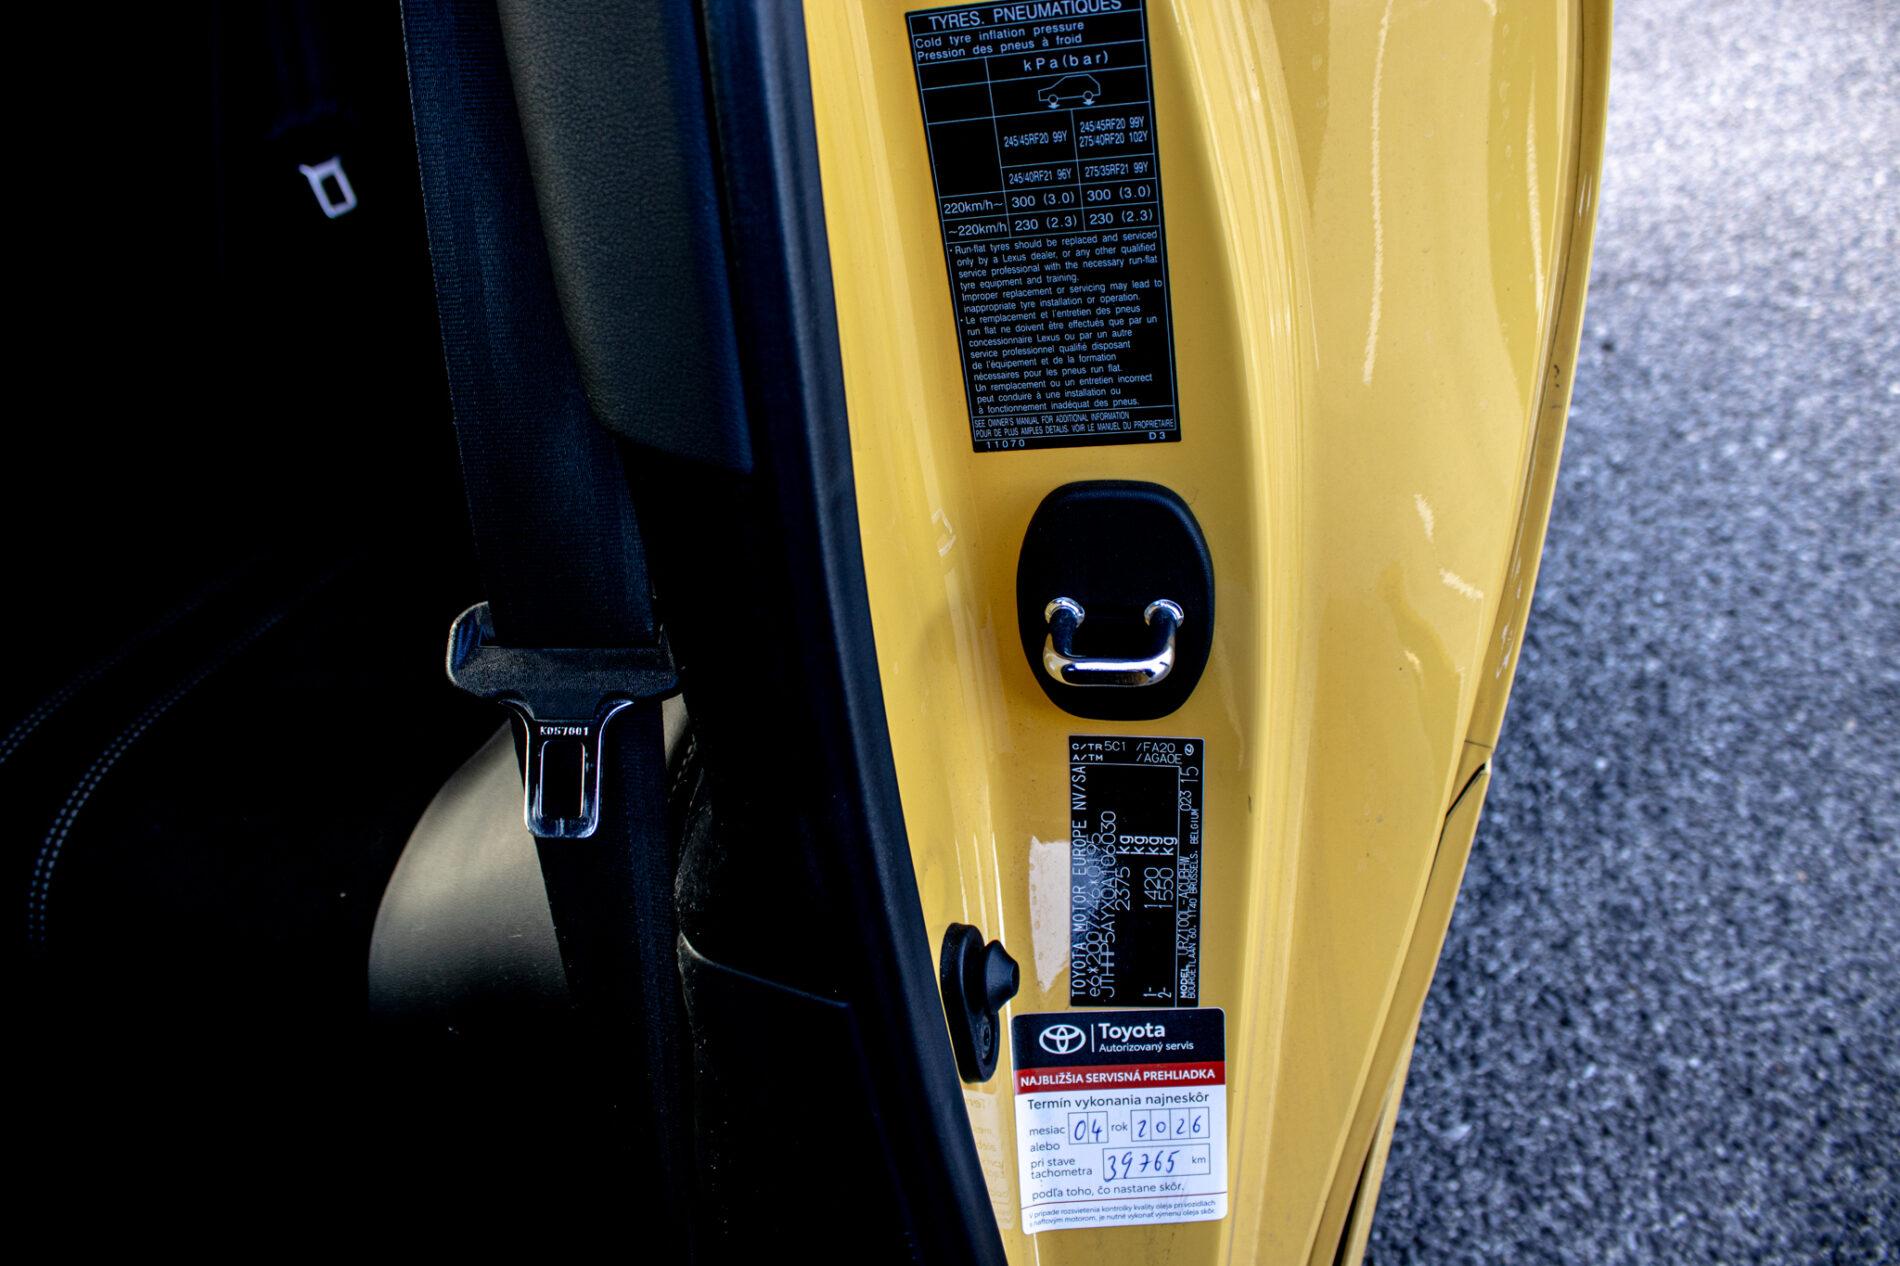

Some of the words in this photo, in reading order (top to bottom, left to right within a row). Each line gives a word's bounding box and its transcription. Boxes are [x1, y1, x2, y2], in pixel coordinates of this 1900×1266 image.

[928, 12, 984, 30] TYRES.
[994, 0, 1122, 22] PNEUMATIQUES
[915, 36, 941, 48] Cold
[948, 34, 971, 46] tyre
[978, 28, 1025, 40] inflation
[1032, 21, 1084, 36] pressure
[917, 44, 965, 60] Pression
[972, 44, 992, 54] des
[1000, 40, 1034, 53] pneus
[1042, 36, 1048, 46] à
[1055, 33, 1082, 44] froid
[1129, 115, 1144, 128] 99Y
[1052, 130, 1066, 142] 99Y
[1128, 130, 1147, 142] 102Y
[1056, 168, 1071, 179] 96Y
[1133, 161, 1148, 173] 99Y
[1011, 195, 1035, 207] 300
[1043, 191, 1074, 204] (3.0)
[1086, 188, 1111, 201] 300
[1119, 184, 1150, 198] (3.0)
[1014, 218, 1038, 230] 230
[1046, 214, 1076, 228] (2.3)
[1089, 212, 1113, 224] 230
[1121, 208, 1152, 222] (2.3)
[989, 243, 1010, 252] tyres
[1014, 238, 1042, 249] should
[1046, 238, 1057, 246] be
[1061, 235, 1097, 246] replaced
[1102, 232, 1118, 242] and
[1122, 230, 1157, 240] serviced
[956, 257, 973, 267] only
[977, 256, 988, 266] by
[1002, 253, 1026, 262] Lexus
[1075, 249, 1090, 257] any
[1094, 246, 1116, 255] other
[1120, 242, 1155, 254] qualified
[958, 268, 986, 278] service
[990, 263, 1040, 276] professional
[1044, 262, 1060, 270] with
[1064, 261, 1078, 269] the
[1082, 258, 1124, 267] necessary
[959, 282, 975, 291] tyre
[979, 277, 1022, 289] equipment
[1026, 275, 1042, 284] and
[1046, 274, 1078, 282] training.
[961, 292, 997, 302] Improper
[1002, 286, 1052, 299] replacement
[1056, 286, 1064, 294] or
[1069, 284, 1105, 293] servicing
[1109, 282, 1127, 291] may
[1131, 279, 1149, 288] lead
[963, 302, 1016, 313] inappropriate
[1019, 301, 1035, 310] tyre
[1039, 297, 1082, 306] installation
[965, 316, 975, 324] Le
[979, 311, 1035, 324] remplacement
[1095, 306, 1110, 315] des
[1115, 305, 1140, 314] pneus
[968, 336, 1032, 347] concessionnaire
[1036, 334, 1060, 342] Lexus
[1079, 332, 1092, 340] par
[1111, 329, 1132, 337] autre
[970, 350, 997, 358] service
[1002, 344, 1054, 357] professionnel
[1091, 340, 1130, 351] disposant
[971, 361, 982, 369] de
[1040, 357, 1048, 365] et
[1052, 356, 1063, 364] de
[1078, 352, 1116, 362] formation
[986, 438, 1024, 448] 11070
[1104, 741, 1126, 752] 5C1
[1180, 766, 1198, 782] 15
[1072, 766, 1086, 810] NV/SA
[1180, 790, 1192, 811] 023
[1190, 809, 1199, 844] BELGIUM
[1072, 820, 1086, 875] EUROPE
[1117, 835, 1134, 854] kg
[1131, 835, 1147, 854] kg
[1145, 836, 1162, 854] kg
[1160, 837, 1177, 855] kg
[1116, 867, 1130, 910] 2375
[1144, 867, 1159, 908] 1420
[1158, 868, 1174, 908] 1550
[1072, 886, 1086, 931] MOTOR
[1072, 943, 1086, 996] TOYOTA
[1181, 965, 1189, 998] MODEL
[1098, 1023, 1166, 1042] Toyota
[1099, 1042, 1163, 1053] Autorizovaný
[1166, 1041, 1194, 1050] servis
[1020, 1073, 1084, 1087] NAJBLIŽŠIA
[1086, 1070, 1141, 1083] SERVISNÁ
[1143, 1069, 1215, 1081] PREHLIADKA
[1028, 1098, 1071, 1110] Termín
[1075, 1093, 1141, 1109] vykonania
[1146, 1092, 1209, 1107] najneskôr
[1029, 1125, 1065, 1136] mesiac
[1111, 1123, 1128, 1132] rok
[1074, 1119, 1103, 1142] 04
[1137, 1114, 1201, 1142] 2026
[1030, 1142, 1060, 1152] alebo
[1030, 1158, 1045, 1168] pri
[1047, 1157, 1075, 1167] stave
[1104, 1150, 1181, 1182] 39765
[1191, 1156, 1206, 1164] km
[1031, 1167, 1093, 1179] tachometra
[1032, 1188, 1064, 1200] podľa
[1066, 1185, 1094, 1196] toho,
[1097, 1185, 1111, 1195] čo
[1114, 1183, 1156, 1194] nastane
[1159, 1182, 1185, 1192] skôr.
